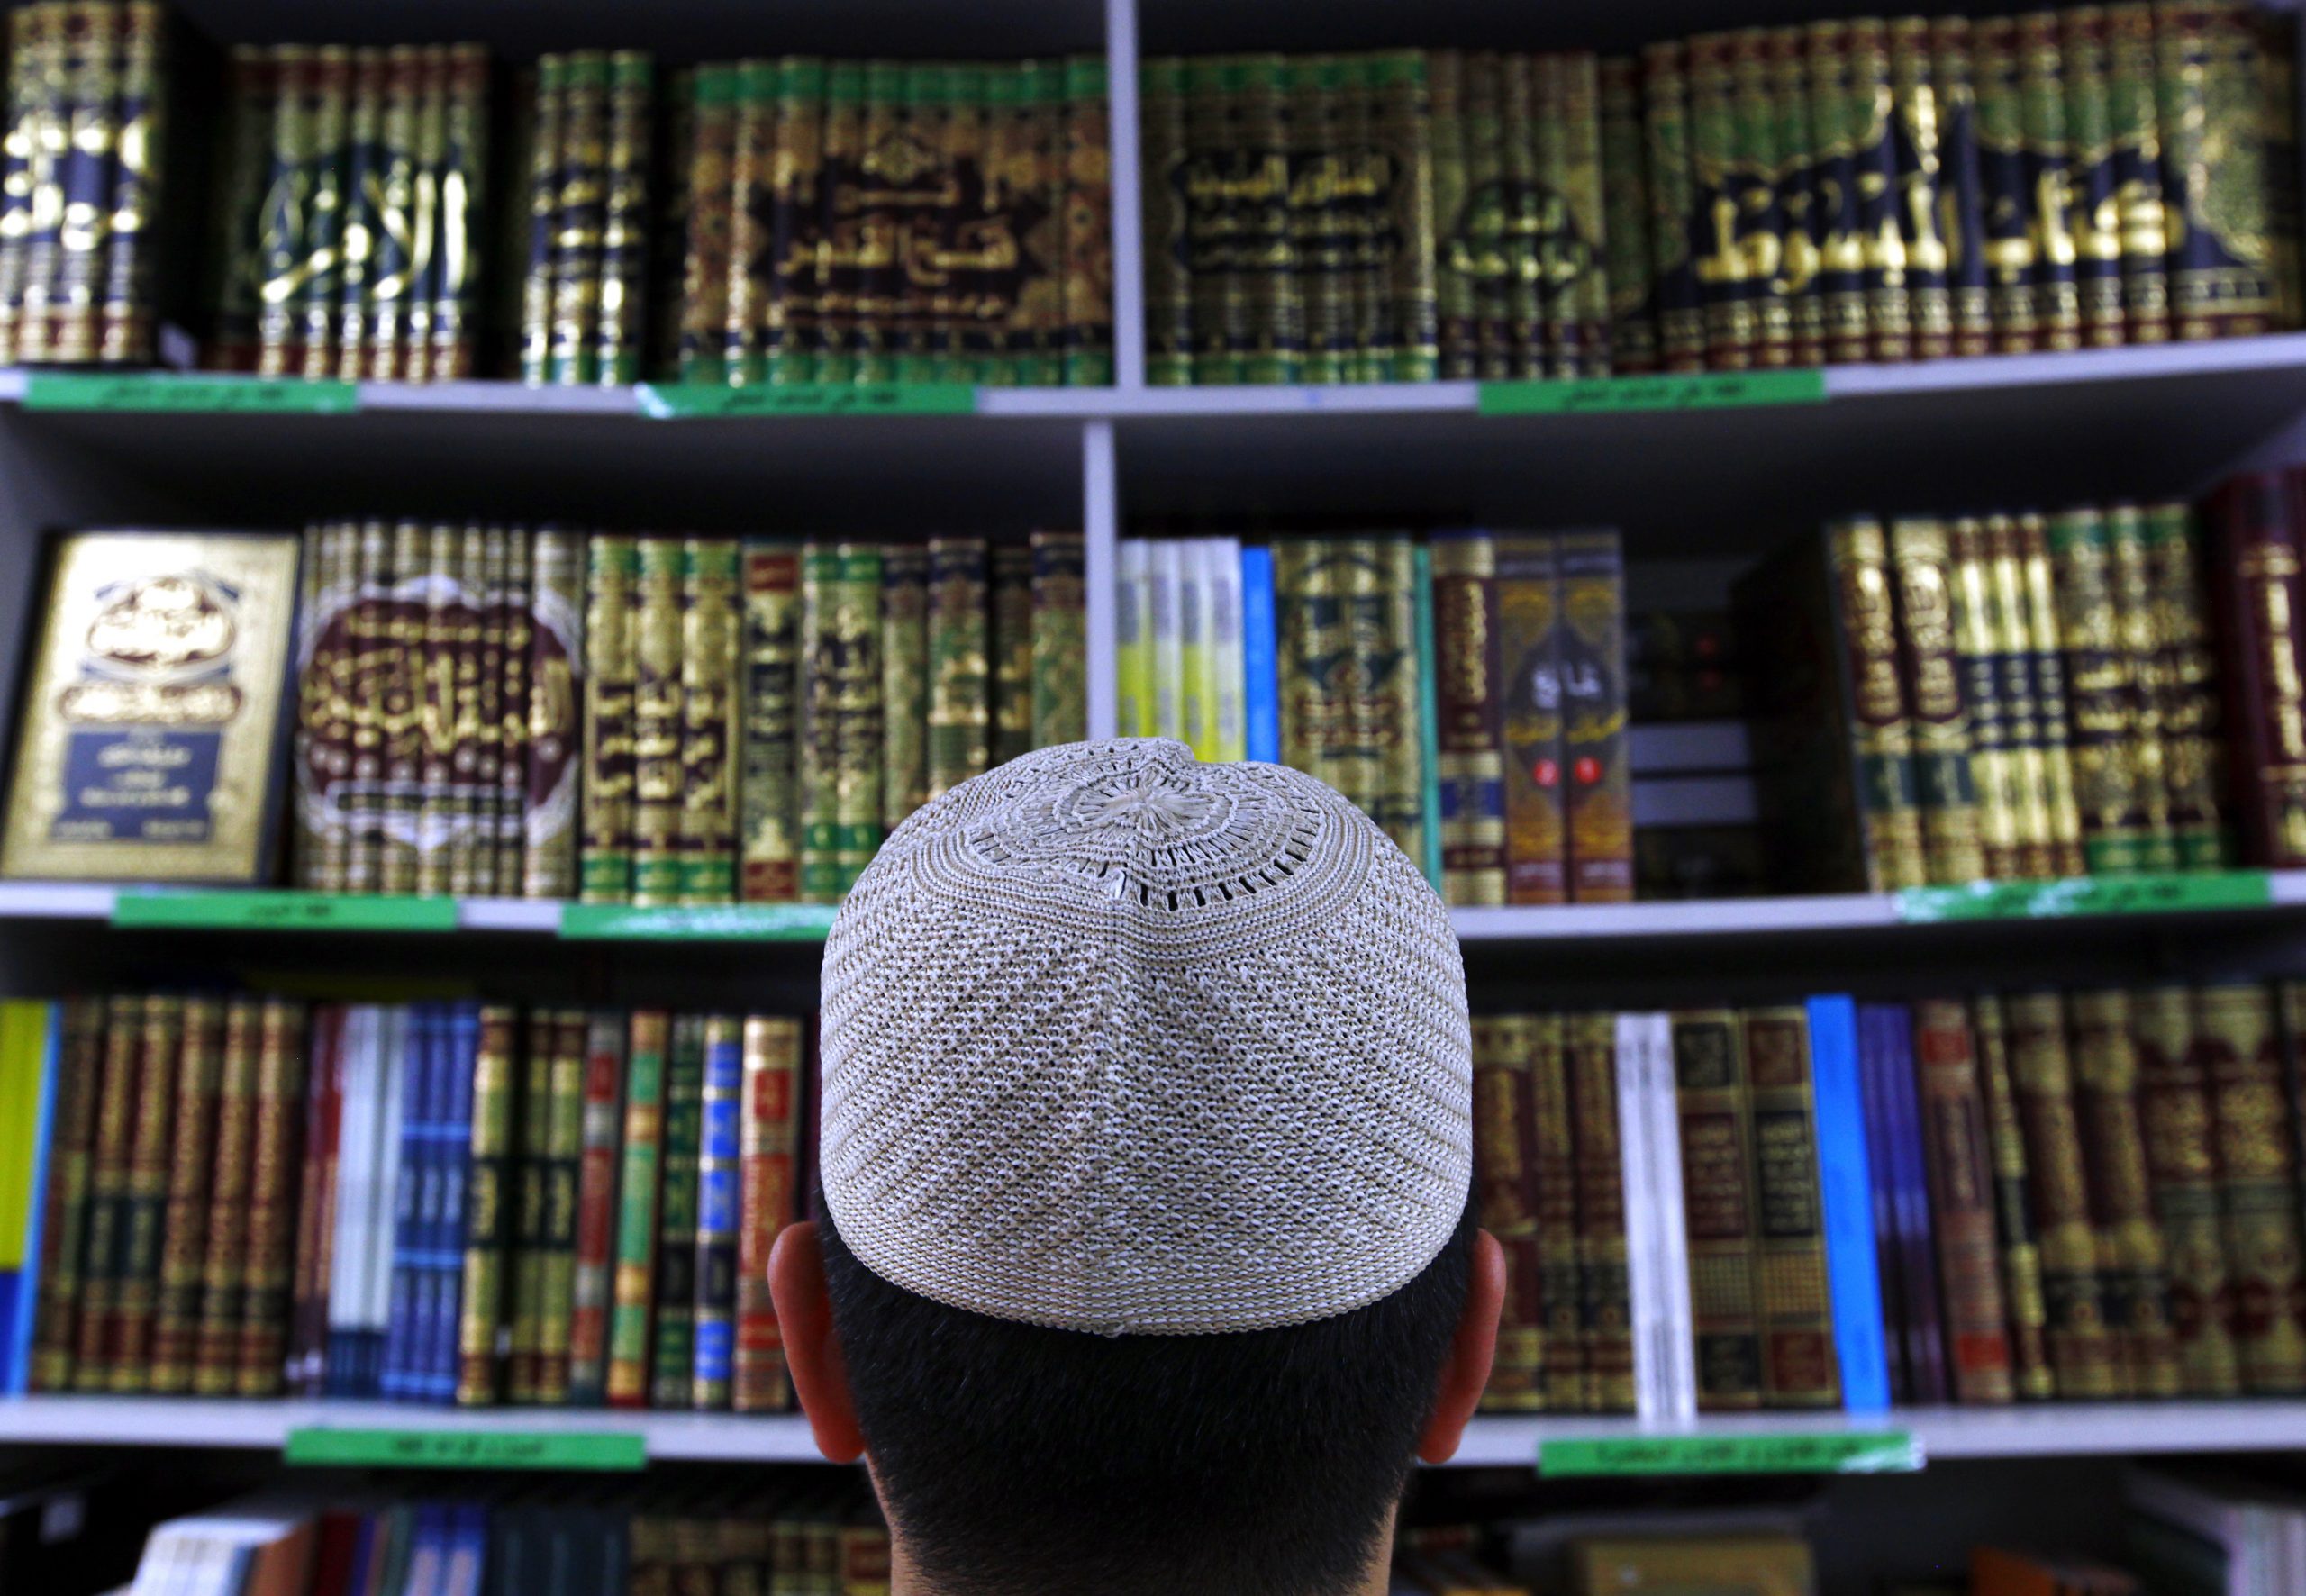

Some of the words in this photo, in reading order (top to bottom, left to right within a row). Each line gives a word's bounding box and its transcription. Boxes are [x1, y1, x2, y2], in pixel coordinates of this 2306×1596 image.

[776, 219, 910, 286] القدير
[906, 213, 1020, 288] فتح
[1697, 171, 1961, 293] المبسوط
